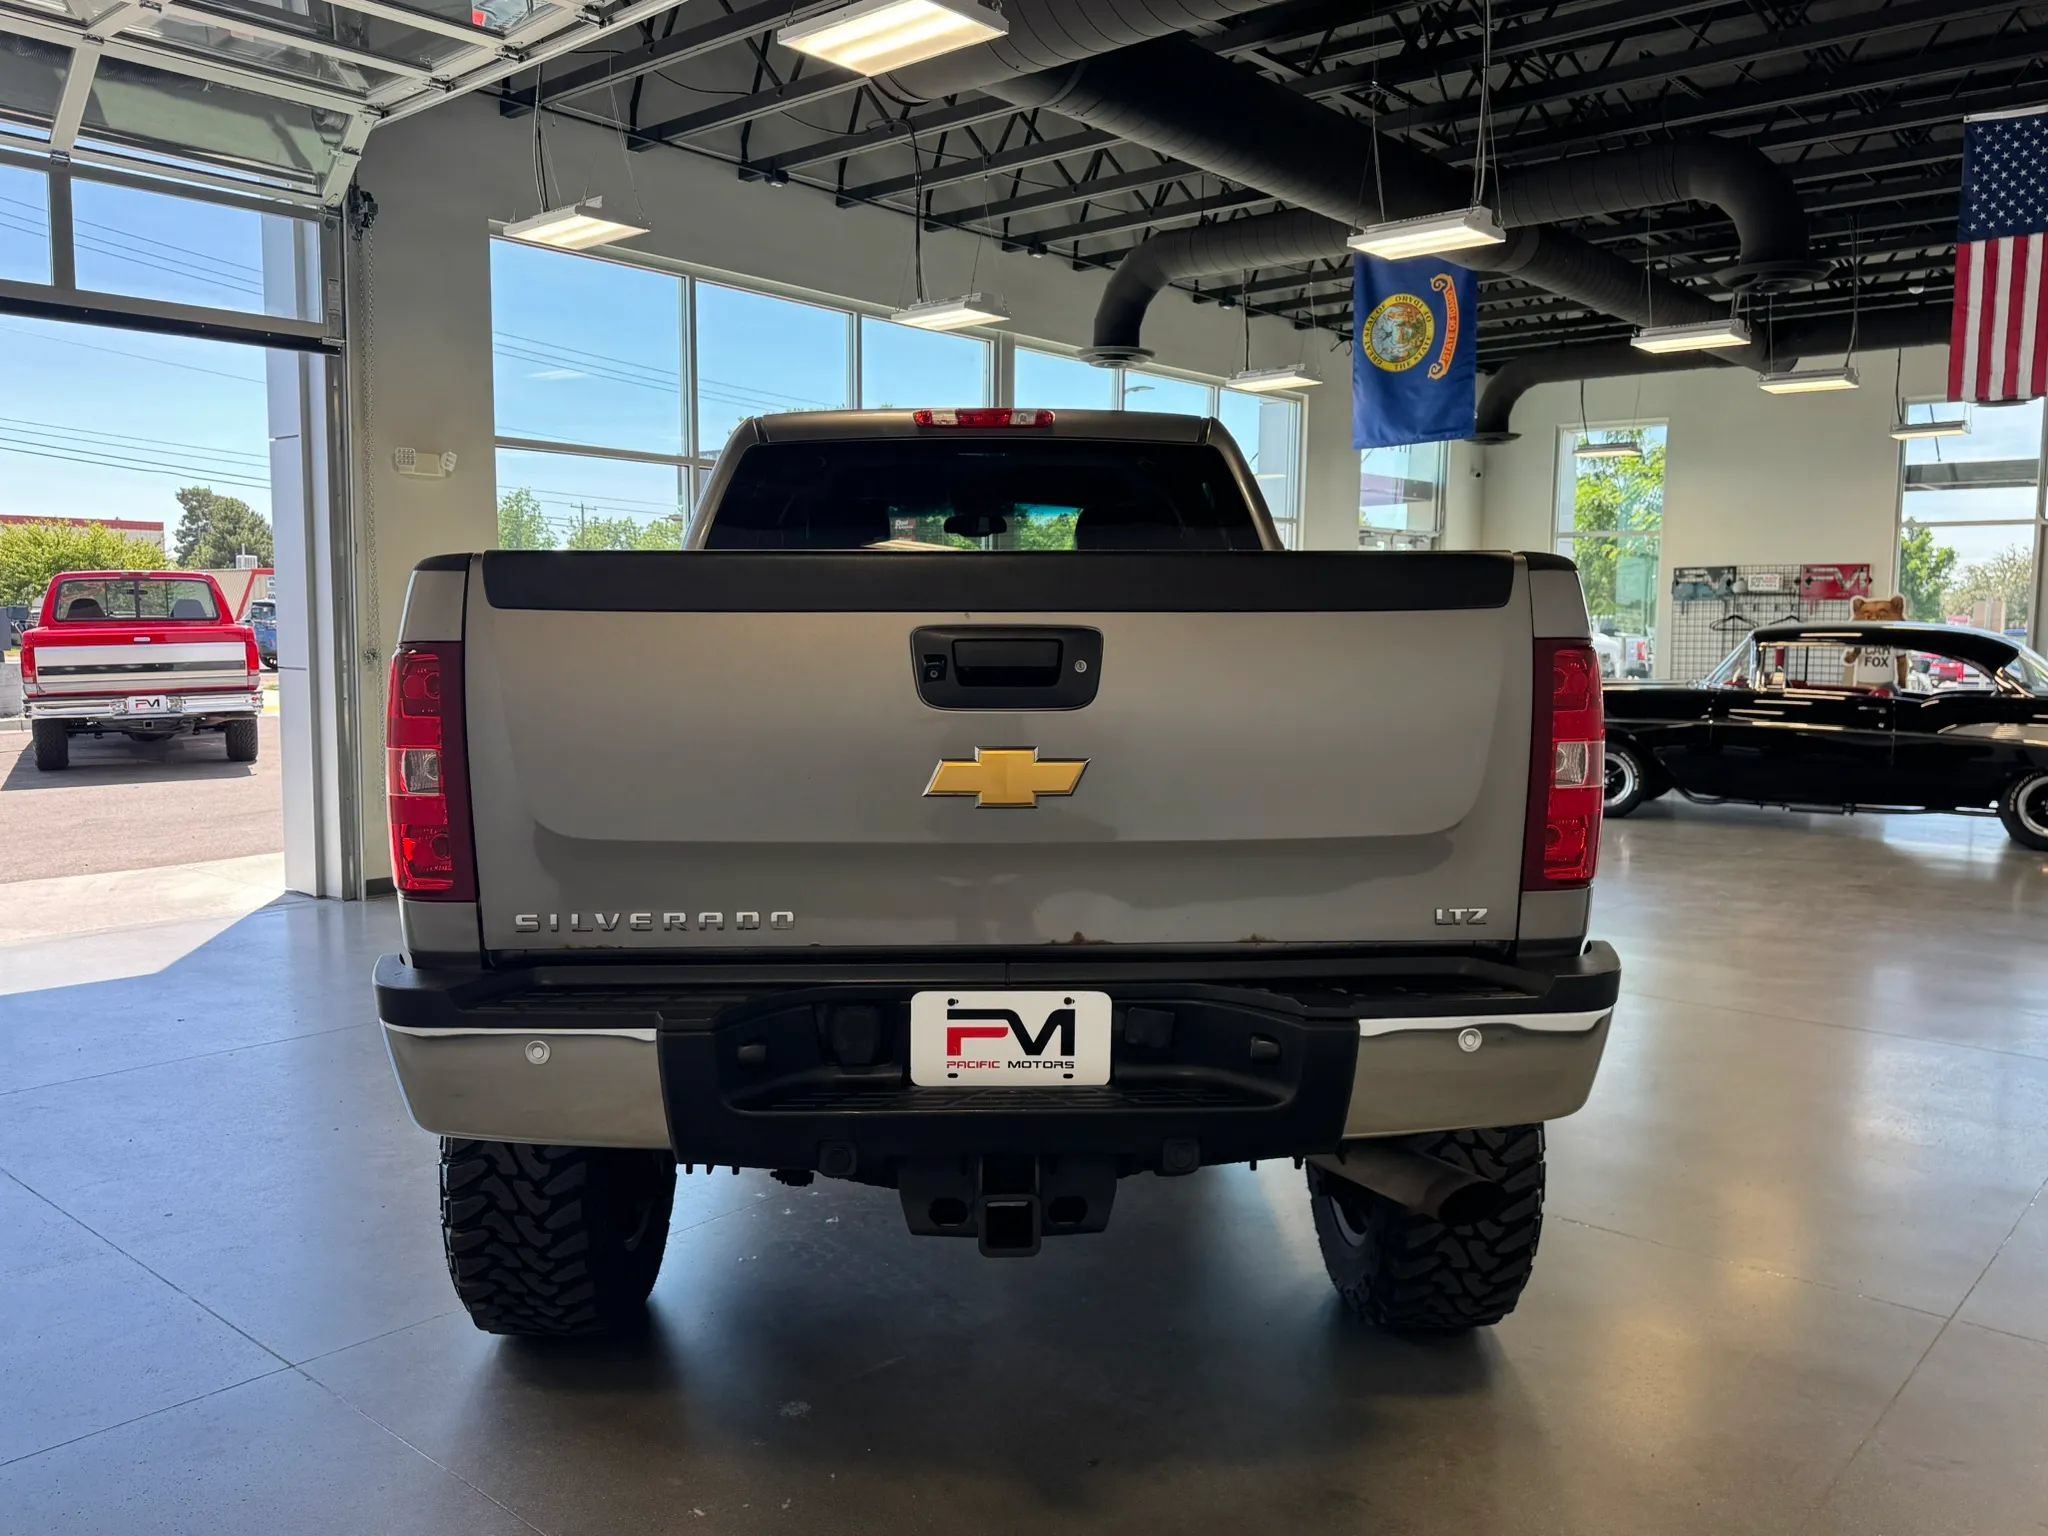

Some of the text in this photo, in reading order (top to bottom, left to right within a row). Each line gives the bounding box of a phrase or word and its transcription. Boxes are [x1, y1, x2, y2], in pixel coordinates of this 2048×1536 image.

[1441, 333, 1454, 361] STATE
[1864, 656, 1889, 667] FOX
[515, 911, 796, 933] SILVERADO
[1435, 908, 1488, 925] LTZ
[946, 1060, 1075, 1069] PACIFIC MOTORS
